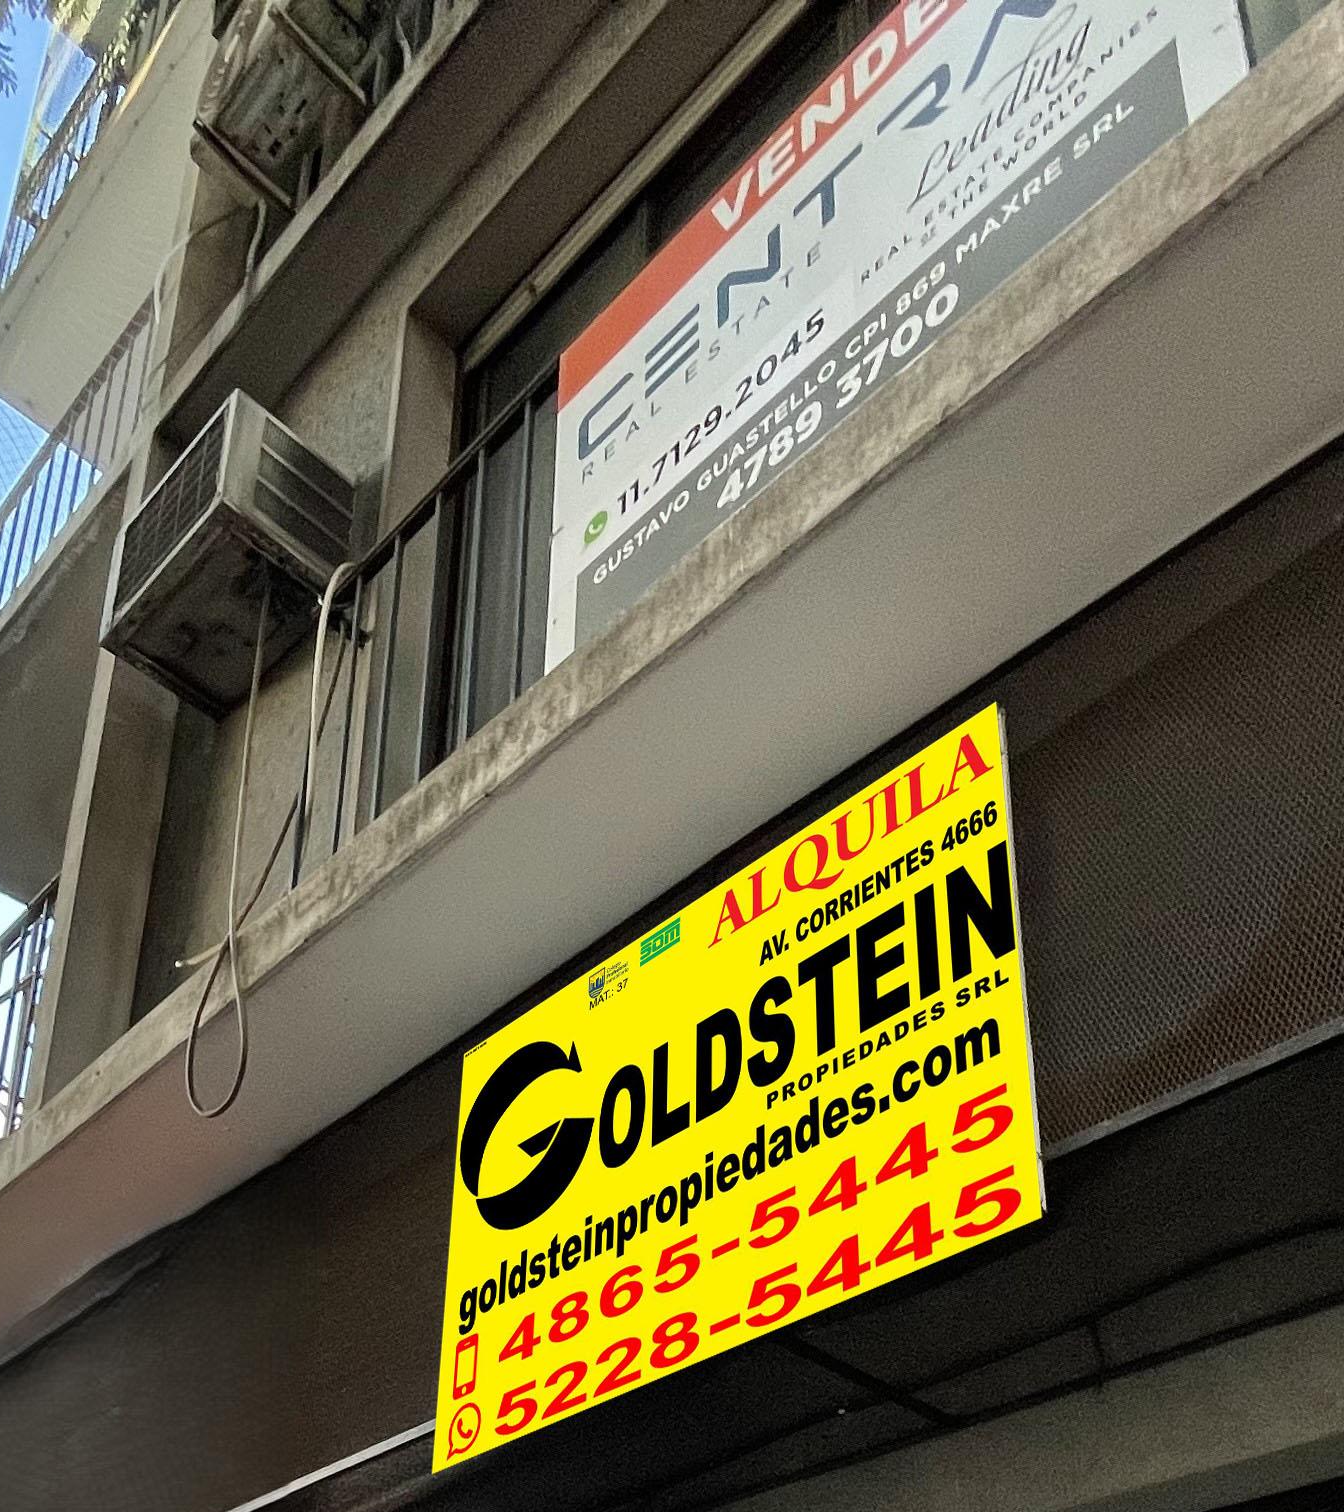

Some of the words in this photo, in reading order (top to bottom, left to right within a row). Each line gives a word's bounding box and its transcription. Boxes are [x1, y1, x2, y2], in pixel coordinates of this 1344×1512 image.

[861, 234, 912, 285] REAL
[924, 146, 1003, 227] ESTATE
[951, 177, 988, 219] THE
[1002, 91, 1087, 170] WORLD
[582, 403, 662, 484] REAL
[685, 241, 822, 384] ESTATE
[593, 489, 690, 584] GUSTAVO
[697, 359, 836, 490] GUASTELLO
[845, 313, 887, 360] CPI
[895, 261, 946, 316] 869
[956, 156, 1063, 264] MAXRE
[1073, 102, 1135, 160] SRL
[617, 308, 825, 515] 11.7129.2045
[716, 400, 822, 509] 4789
[835, 283, 960, 409] 3700
[708, 733, 993, 947] ALQUILA
[759, 929, 790, 967] AV.
[795, 839, 935, 942] CORRIENTES
[941, 800, 998, 851] 4666
[460, 840, 1016, 1231] GOLDSTEIN
[766, 1001, 945, 1110] PROPIEDADES
[955, 969, 1010, 1008] SRL
[458, 1018, 1001, 1336] goldsteinpropiedades.com
[498, 1083, 1014, 1361] 4865-5445
[495, 1165, 1022, 1436] 5228-5445
